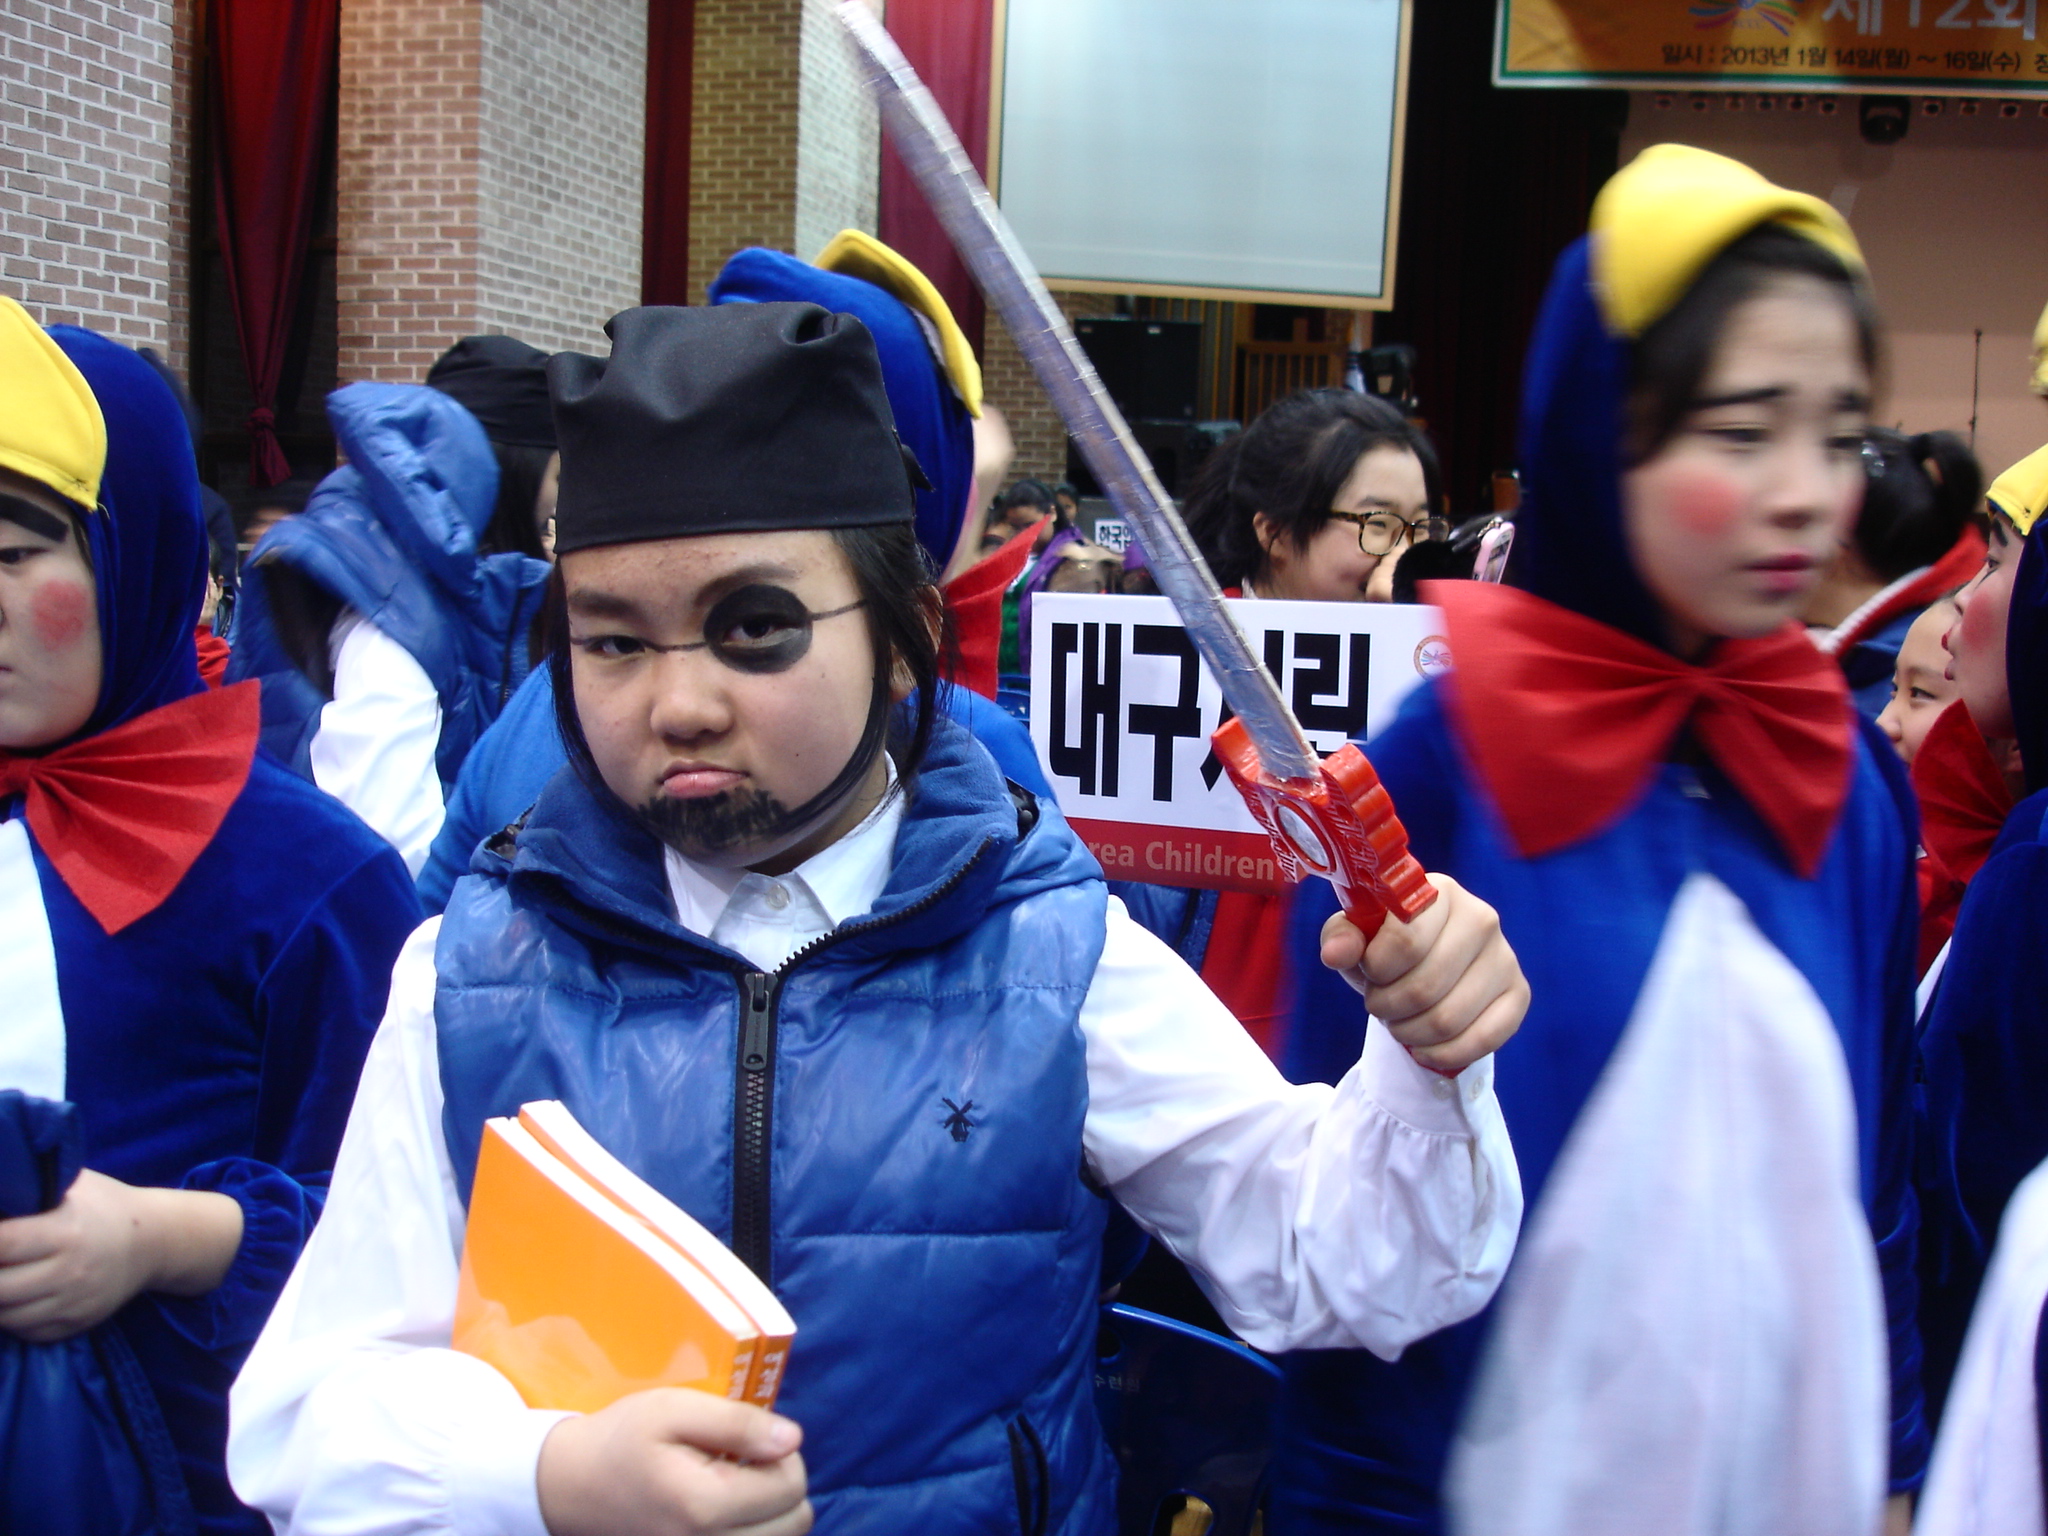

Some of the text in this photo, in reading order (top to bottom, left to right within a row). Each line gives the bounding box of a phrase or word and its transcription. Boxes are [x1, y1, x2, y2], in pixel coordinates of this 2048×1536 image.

[1722, 46, 1790, 67] 2013년
[1050, 622, 1370, 802] 대구립
[1145, 840, 1275, 882] Children
